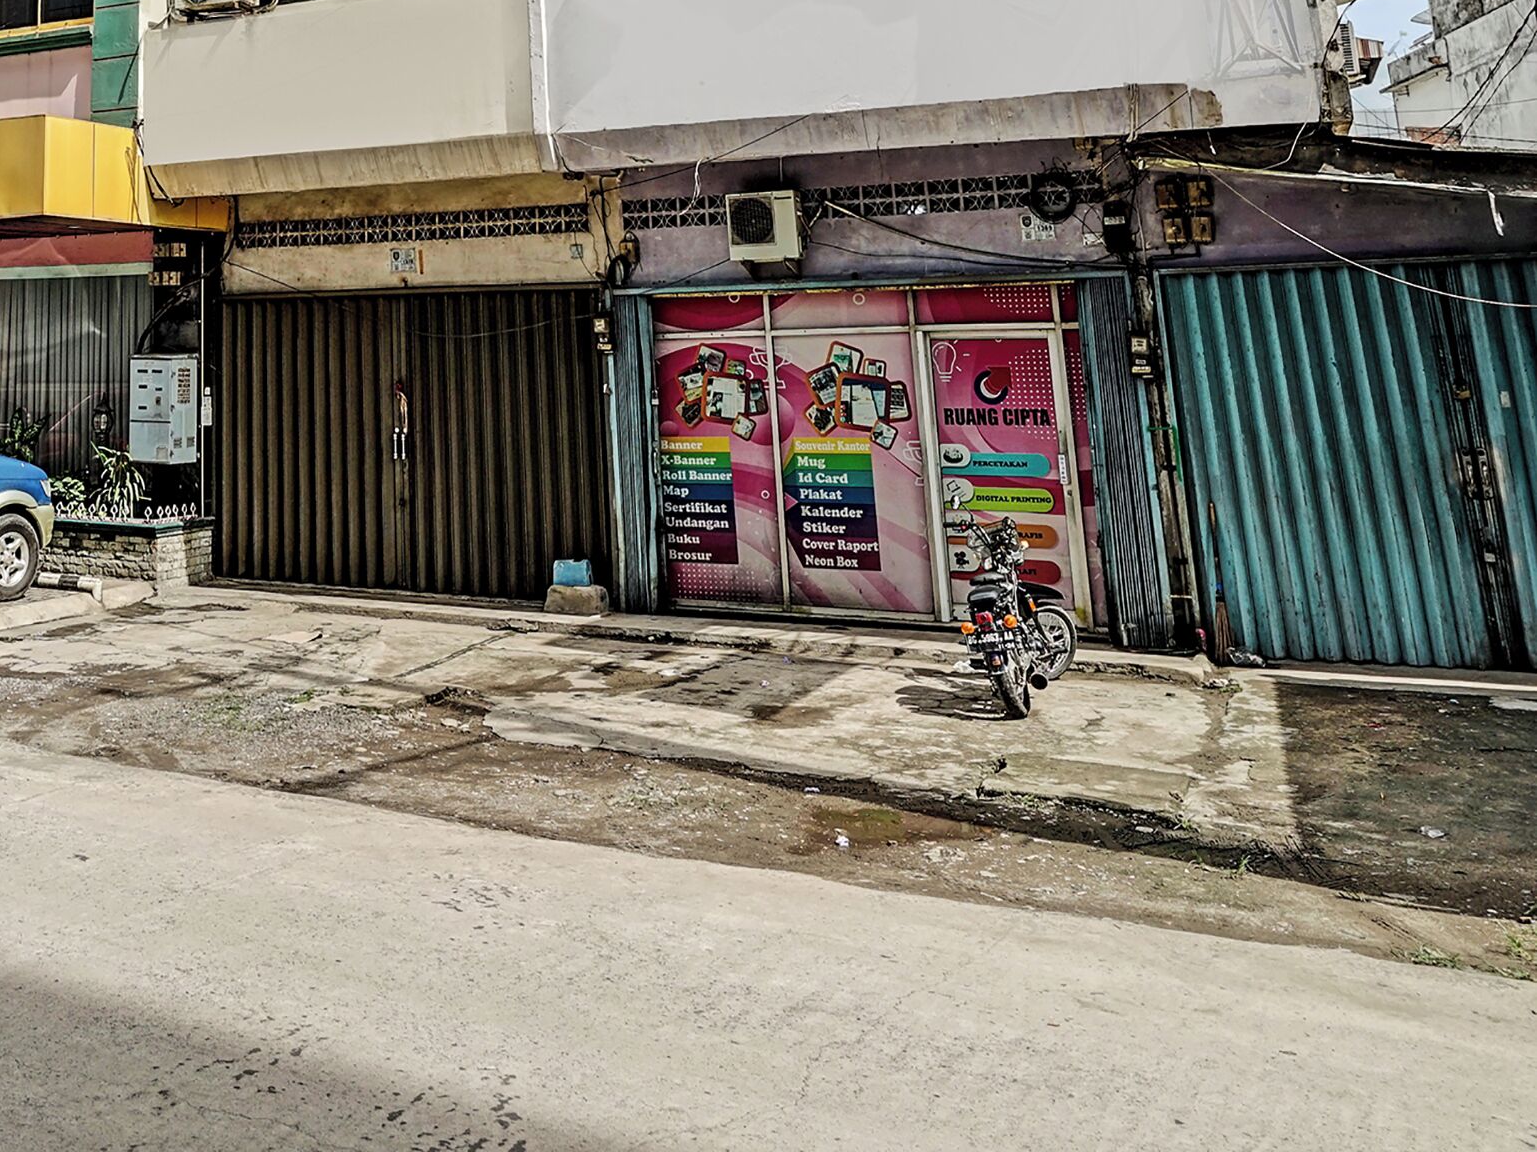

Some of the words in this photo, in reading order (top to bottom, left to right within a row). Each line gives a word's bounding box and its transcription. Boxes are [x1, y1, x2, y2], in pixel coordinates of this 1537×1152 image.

[944, 408, 999, 426] RUANG
[1002, 408, 1051, 426] CIPTA
[661, 440, 703, 450] Banner
[794, 440, 835, 451] Souvenir
[837, 441, 870, 452] Kantor
[661, 456, 716, 466] X-Banner
[797, 456, 826, 469] Mug
[973, 460, 1028, 468] PERCETAKAN
[662, 470, 687, 481] Roll
[689, 471, 733, 481] Banner
[798, 473, 812, 483] Id
[816, 473, 848, 484] Card
[663, 485, 689, 498] Map
[800, 488, 843, 500] Plakat
[976, 495, 1009, 503] DIGITAL
[1011, 496, 1051, 504] PRINTING
[664, 502, 727, 514] Sertifikat
[801, 506, 863, 518] Kalender
[666, 516, 729, 530] Undangan
[803, 522, 846, 534] Stiker
[668, 534, 700, 544] Buku
[803, 539, 835, 550] Cover
[837, 539, 879, 552] Raport
[669, 550, 712, 561] Brosur
[805, 555, 835, 567] Neon
[836, 556, 859, 567] Box
